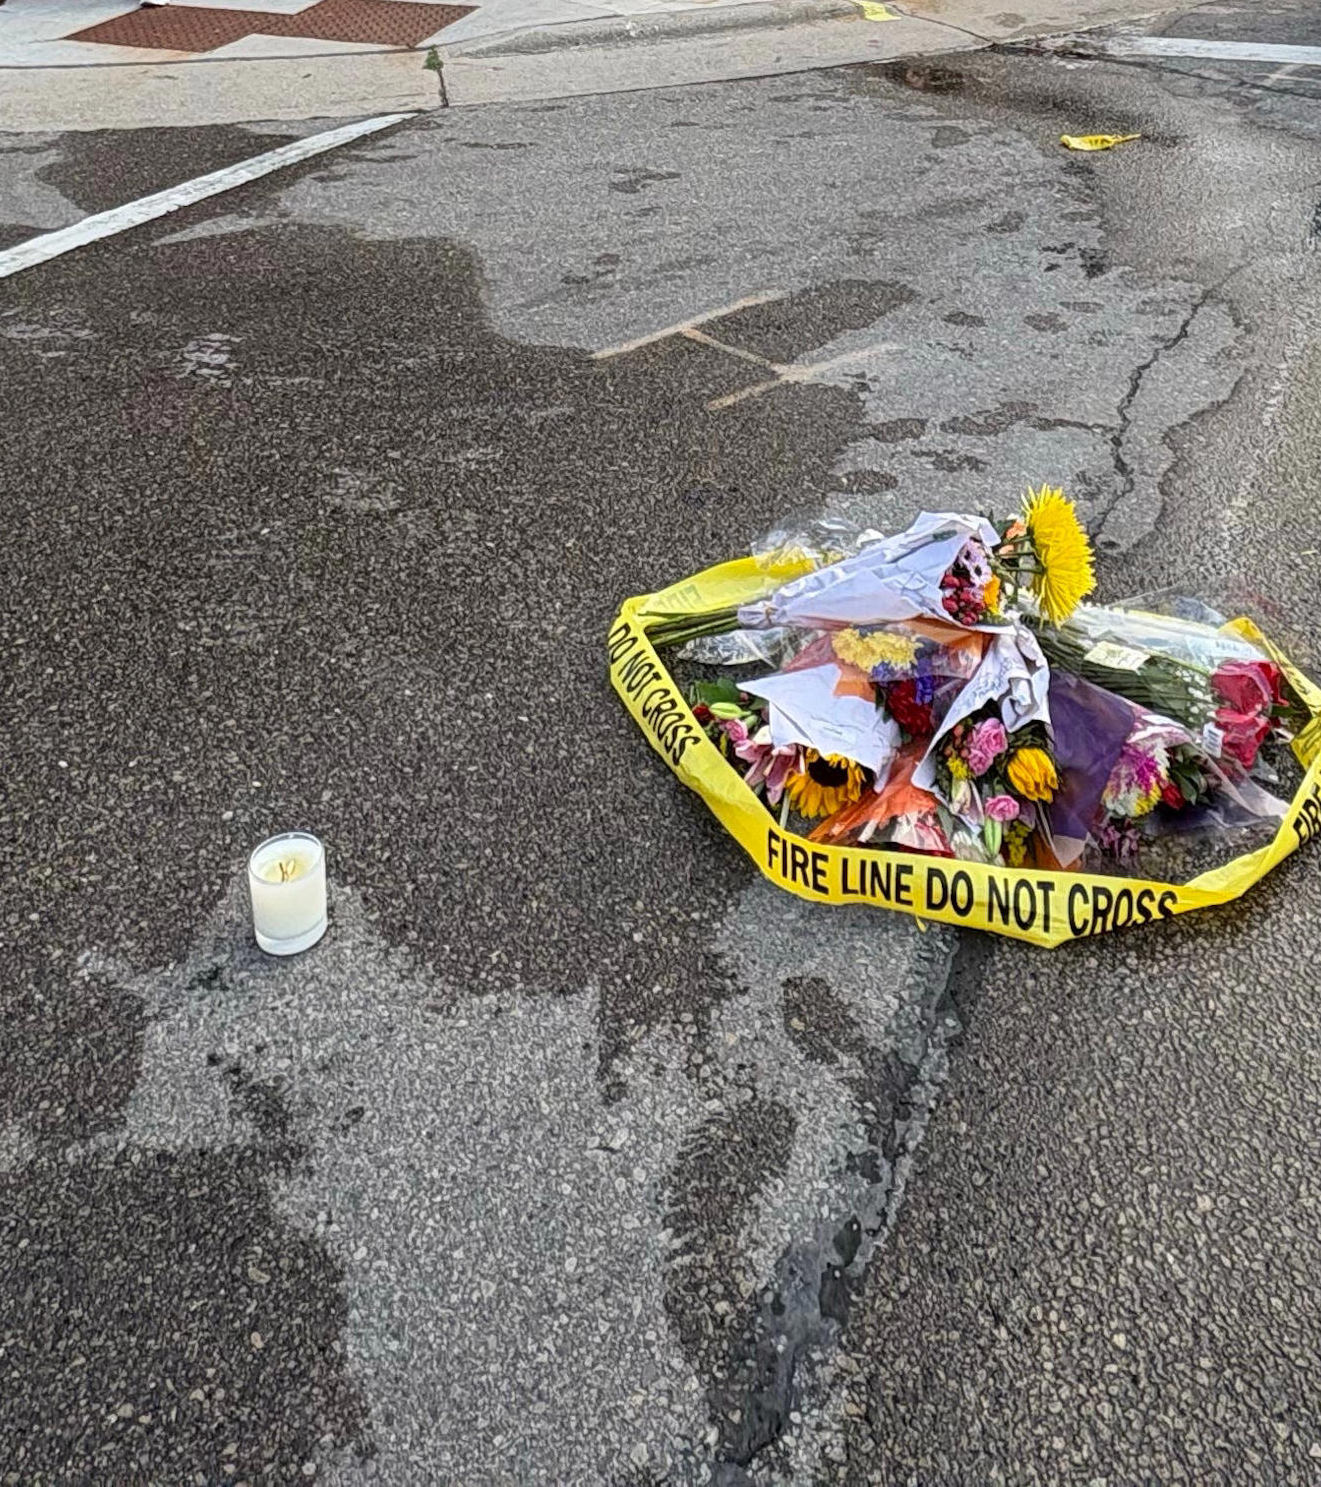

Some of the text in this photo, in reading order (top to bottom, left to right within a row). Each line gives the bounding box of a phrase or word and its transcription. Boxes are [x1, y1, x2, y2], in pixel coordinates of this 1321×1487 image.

[608, 623, 701, 766] DO NOT CROSS
[767, 828, 1178, 936] FIRE LINE DO NOT CROSS
